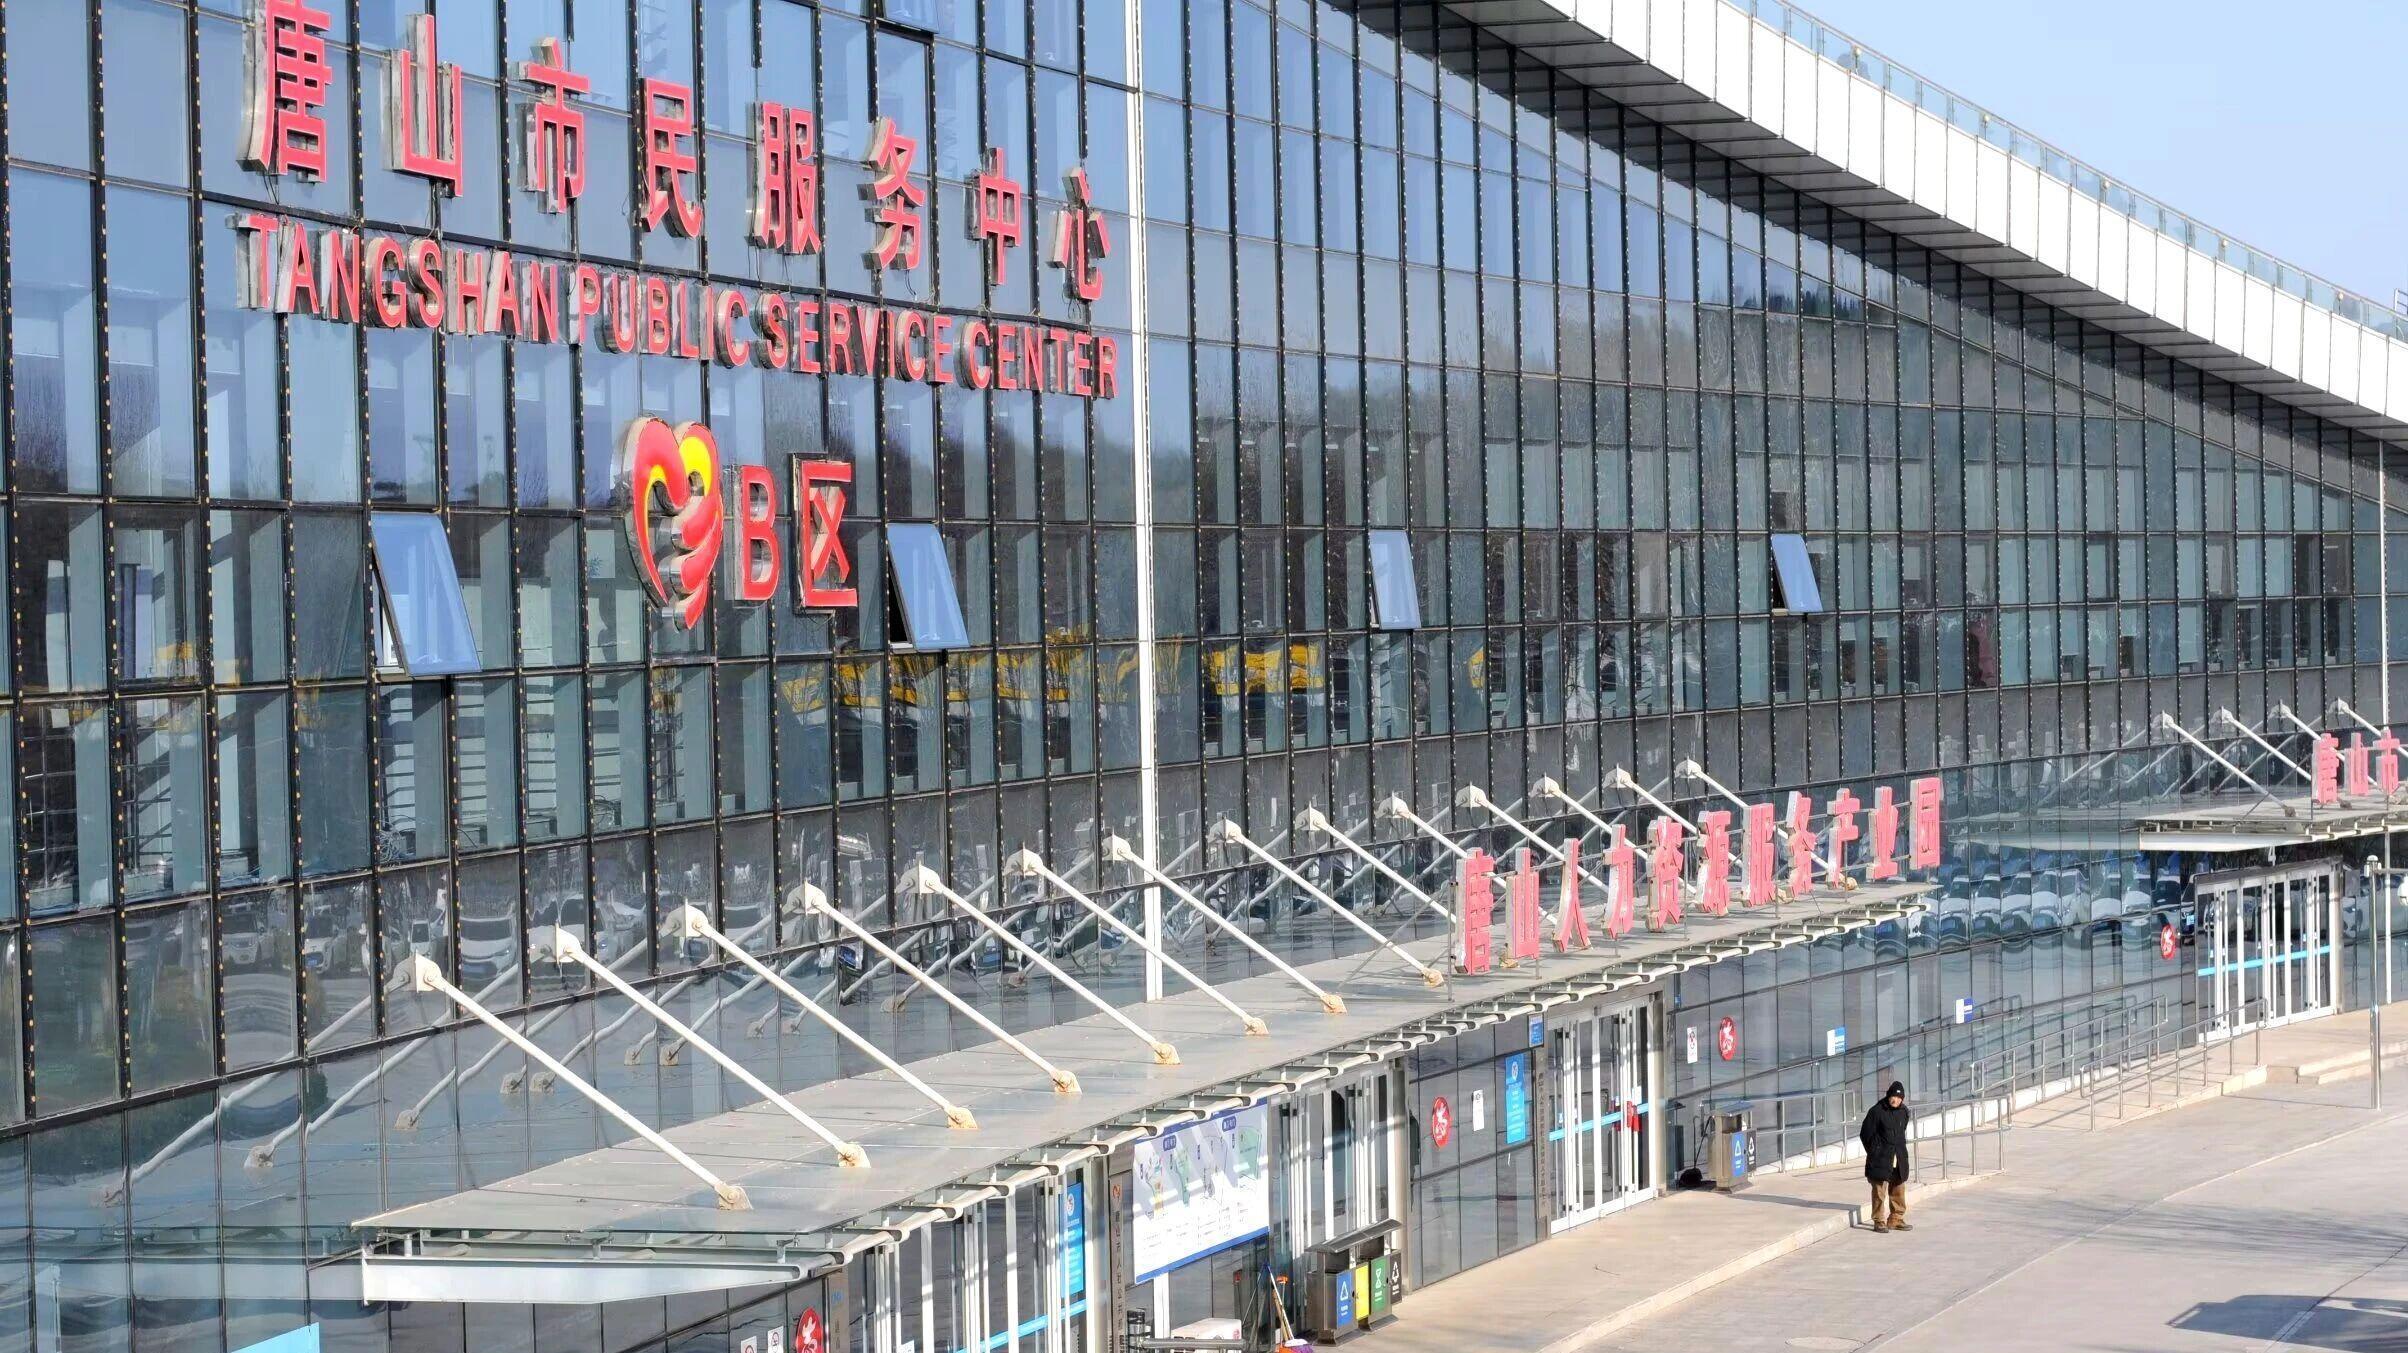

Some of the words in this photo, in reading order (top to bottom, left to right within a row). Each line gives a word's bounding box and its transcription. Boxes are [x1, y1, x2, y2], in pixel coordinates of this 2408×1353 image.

[238, 0, 1111, 300] 唐山市民服务中心
[233, 215, 559, 343] TANGSHAN
[572, 265, 749, 367] PUBLIC
[757, 293, 953, 384] SERVICE
[957, 321, 1119, 398] CENTER
[736, 456, 858, 612] B区
[1455, 777, 1941, 975] 唐山人力资源服务产业园
